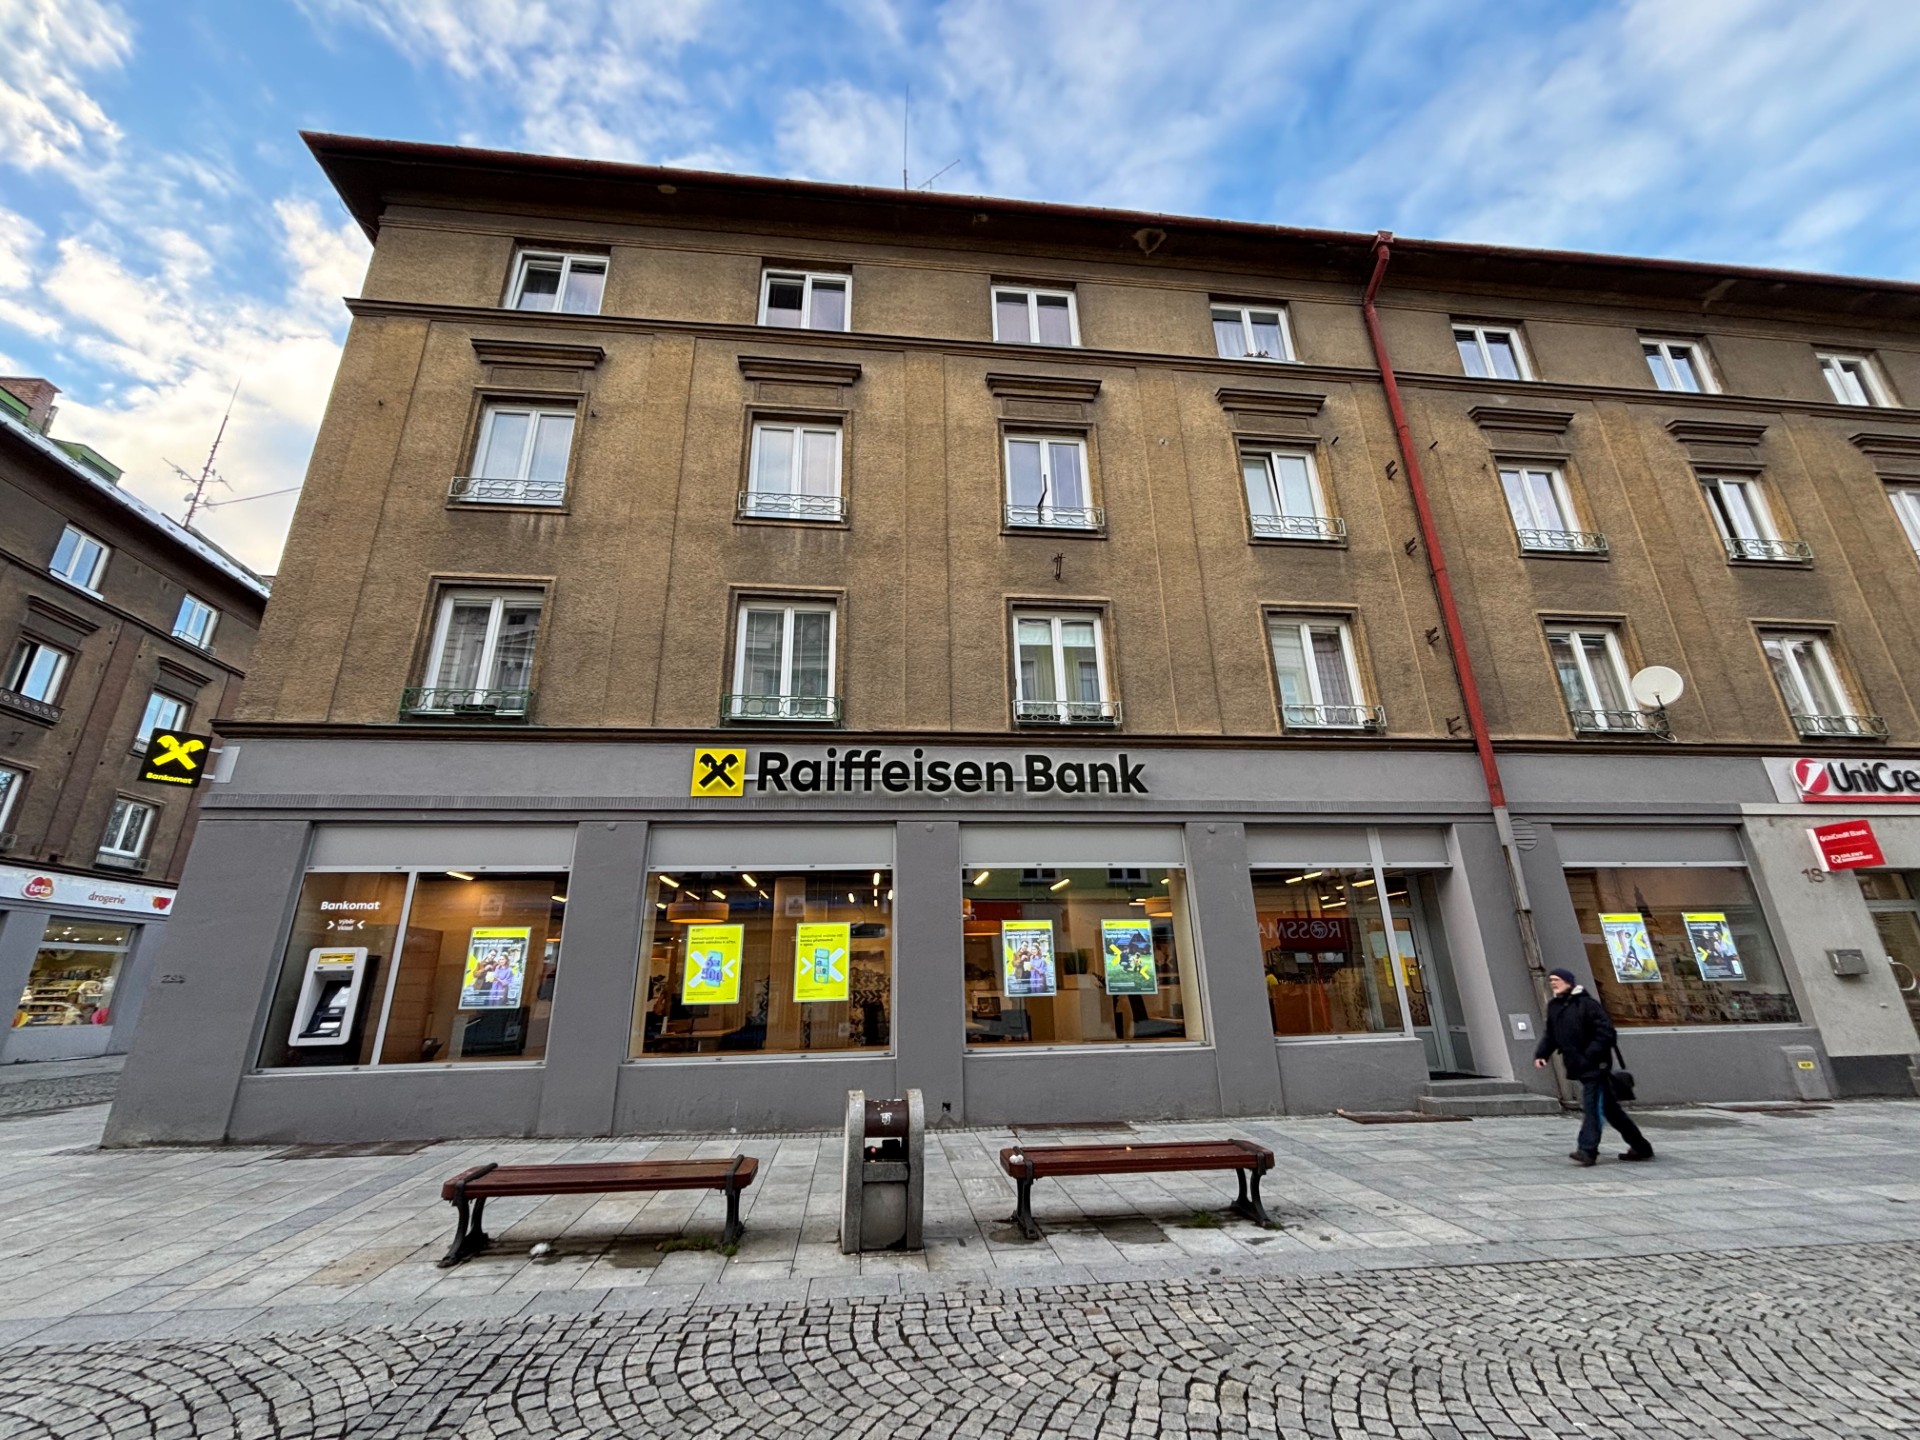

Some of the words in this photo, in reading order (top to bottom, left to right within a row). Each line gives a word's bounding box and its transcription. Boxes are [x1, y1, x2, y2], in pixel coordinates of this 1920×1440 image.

[146, 772, 193, 784] Bankomat
[757, 748, 1013, 793] Raiffeisen
[1024, 753, 1148, 794] Bank
[1827, 762, 1920, 792] UniCre
[1801, 868, 1825, 883] 18
[29, 884, 51, 894] teta
[88, 891, 126, 905] drogerie
[320, 900, 381, 910] Bankomat
